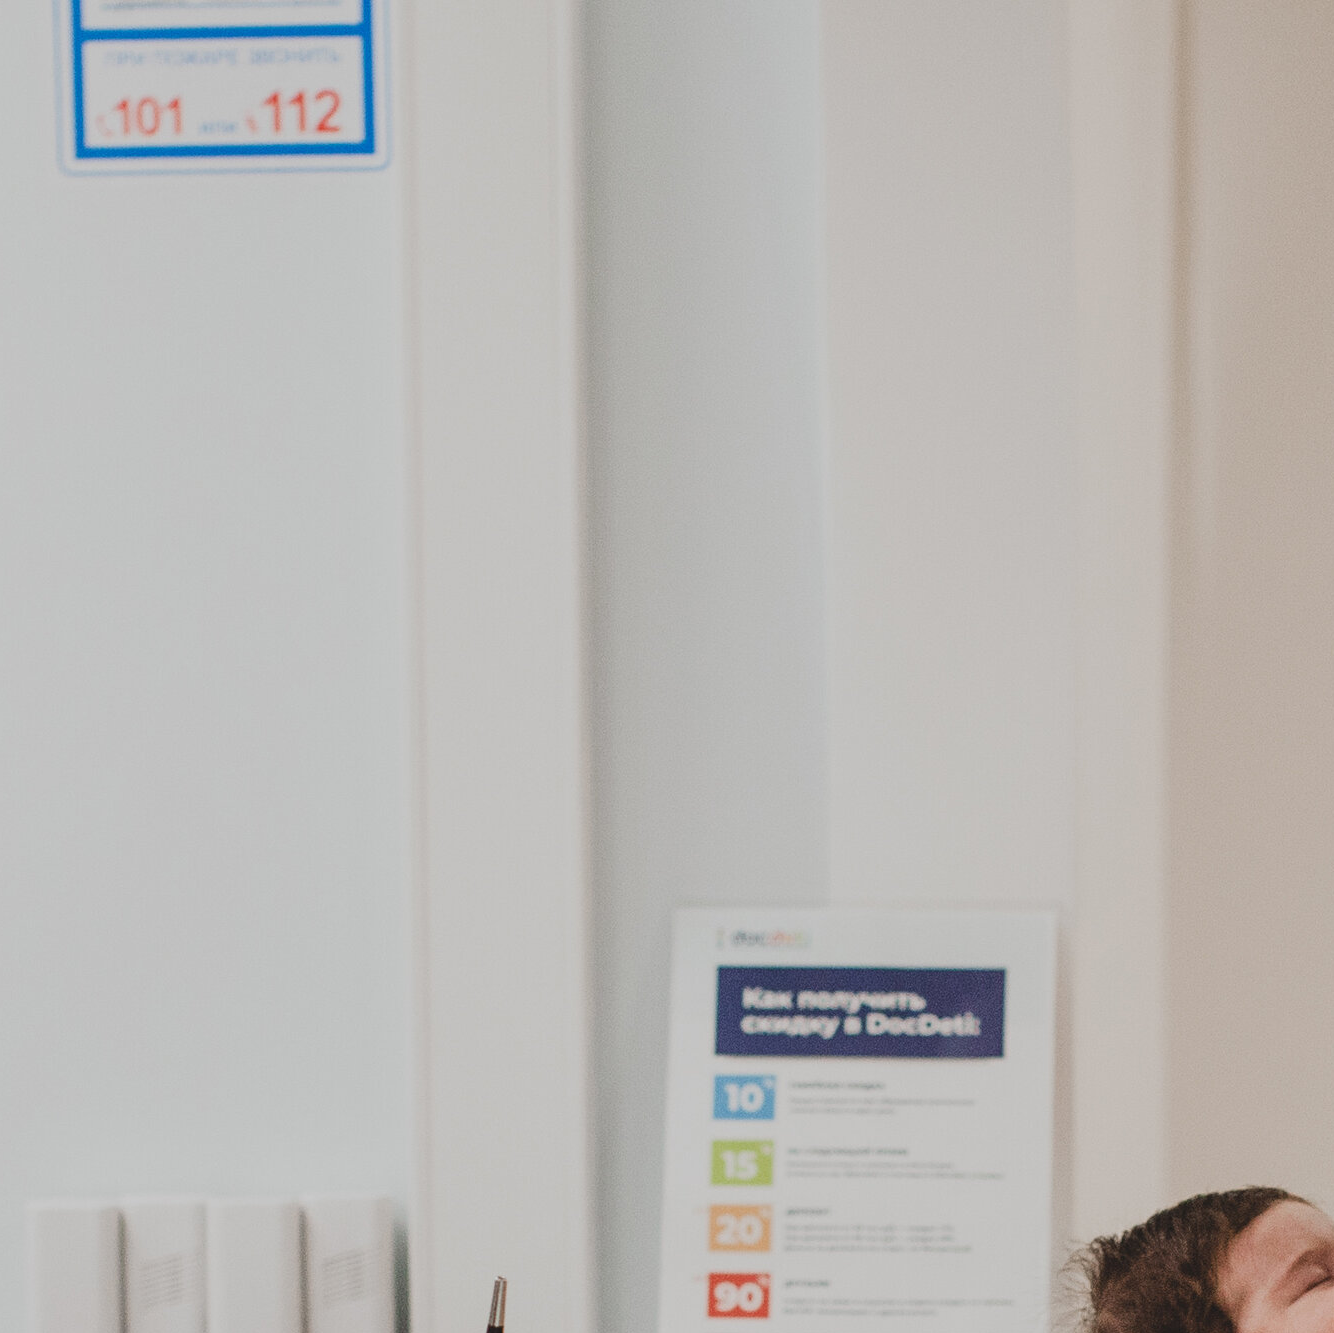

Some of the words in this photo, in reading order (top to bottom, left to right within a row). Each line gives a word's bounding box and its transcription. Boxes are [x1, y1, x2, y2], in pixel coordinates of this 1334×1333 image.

[114, 96, 183, 136] 101
[261, 89, 341, 134] 112
[742, 987, 793, 1010] Как
[796, 990, 927, 1014] получить
[740, 1015, 840, 1039] скидку
